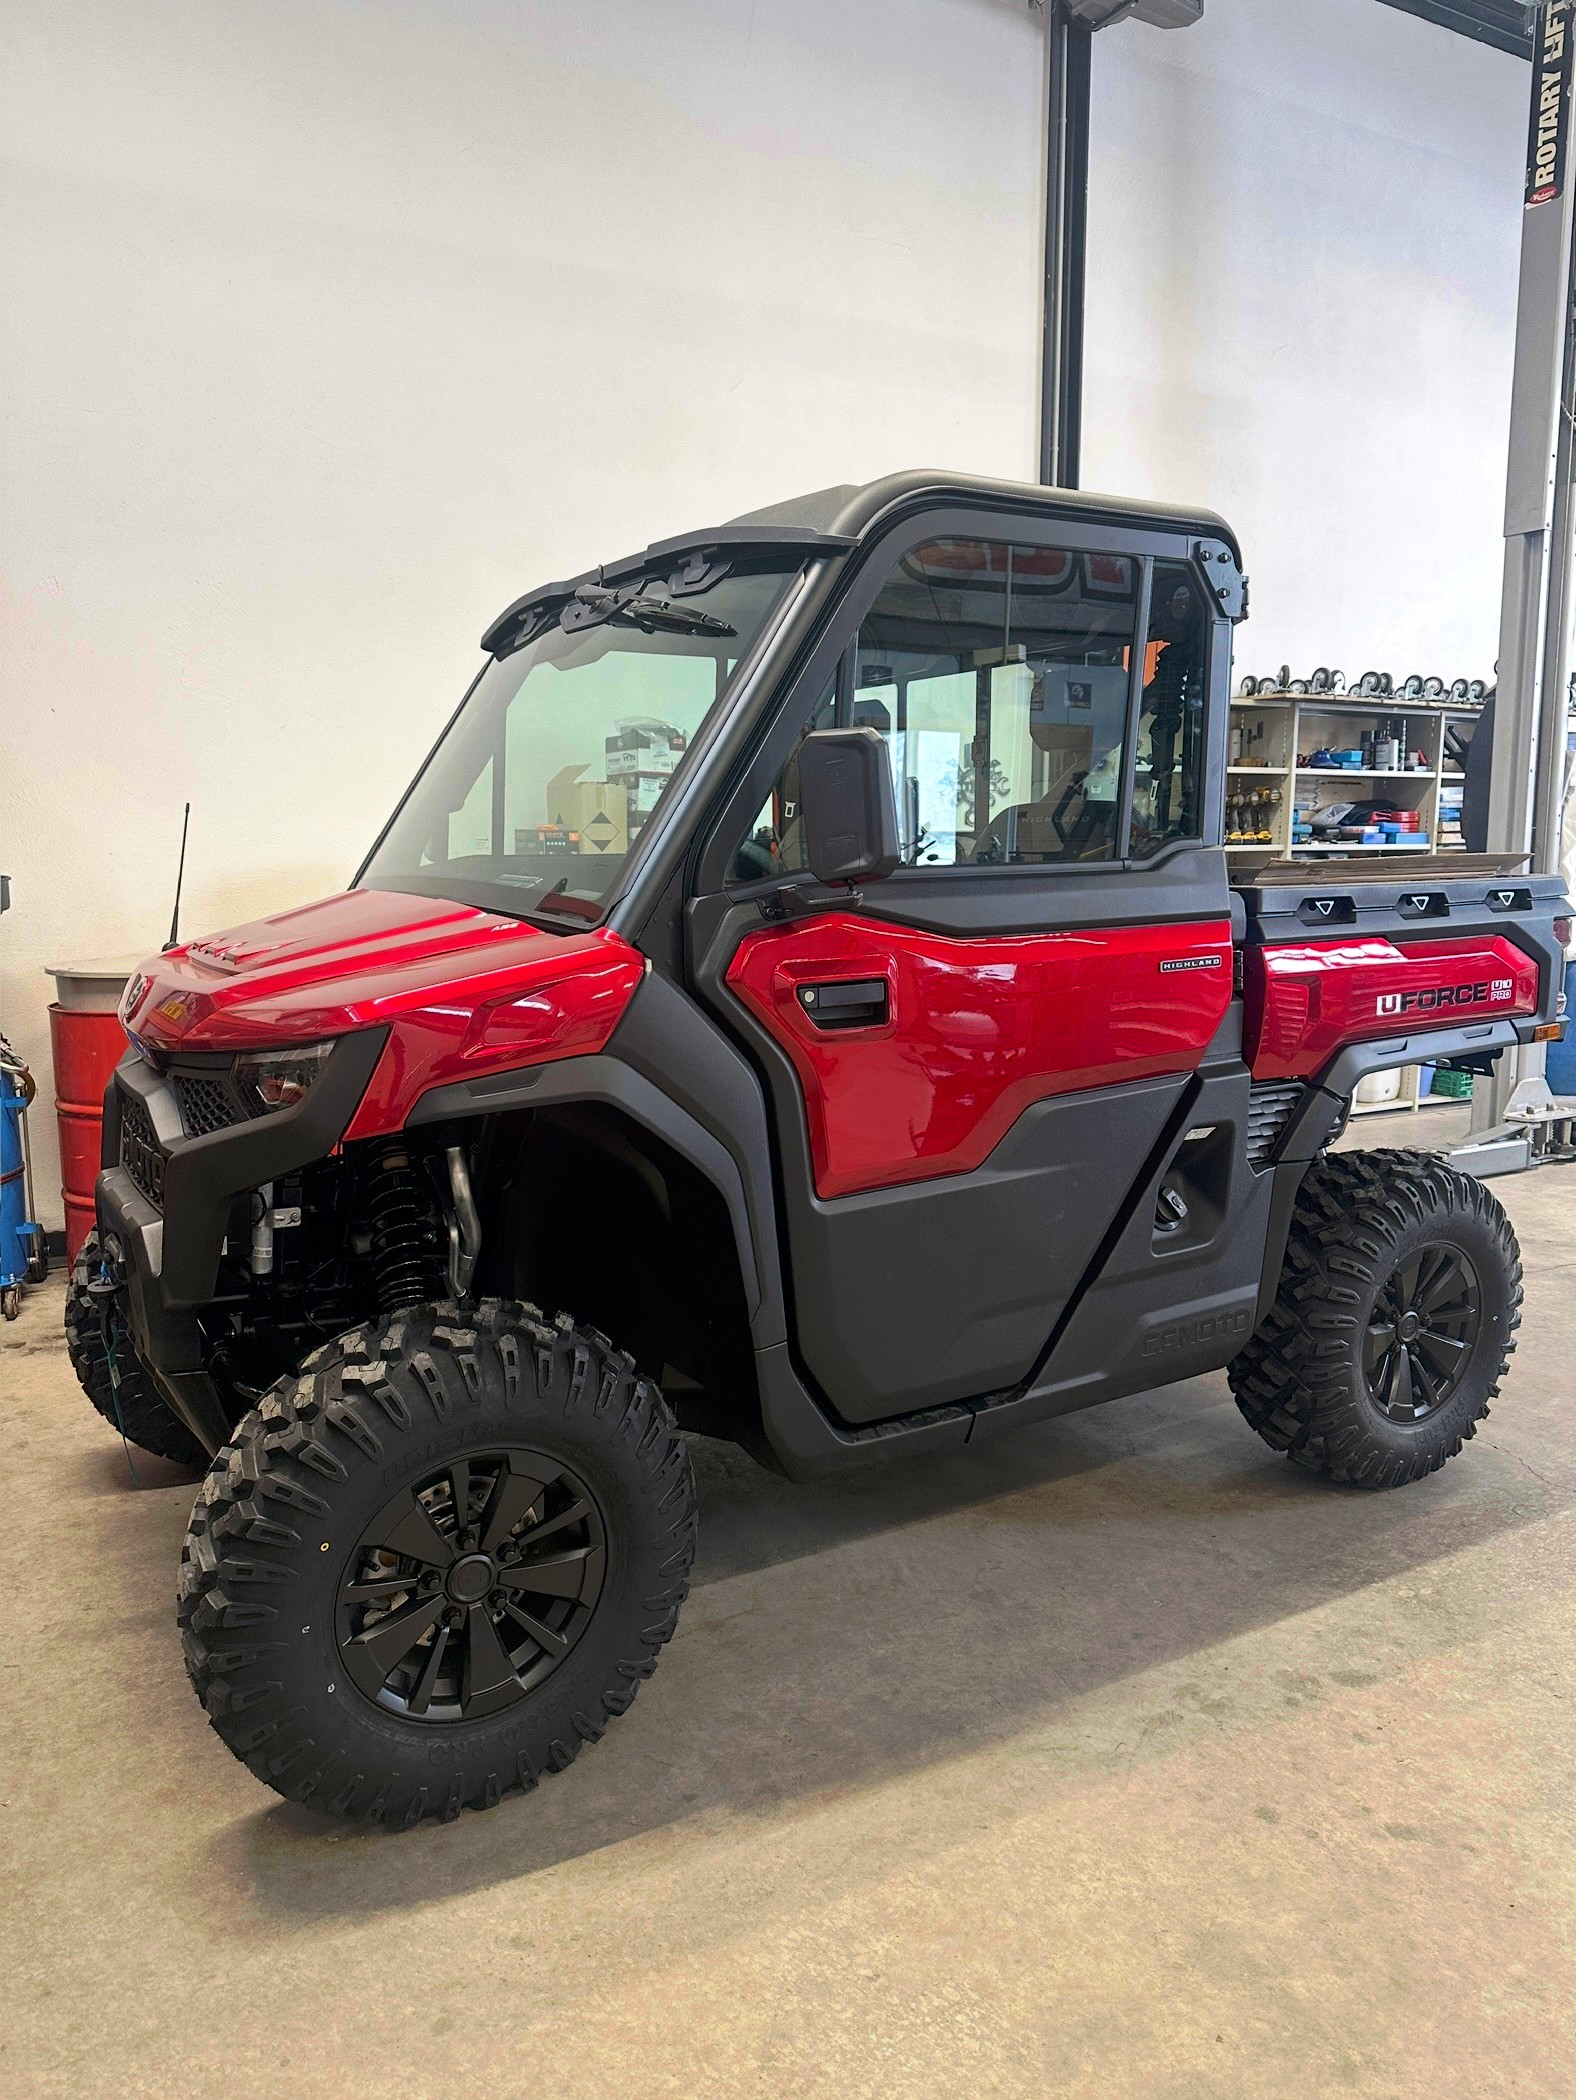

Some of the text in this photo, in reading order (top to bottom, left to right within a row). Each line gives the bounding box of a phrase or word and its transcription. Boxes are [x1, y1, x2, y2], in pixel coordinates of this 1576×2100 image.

[1535, 0, 1568, 188] ROTARY LIFT
[1163, 958, 1220, 969] HIGHLAND
[1491, 979, 1513, 990] U10
[1491, 990, 1512, 1001] PRO
[1141, 1309, 1250, 1357] CFMOTO
